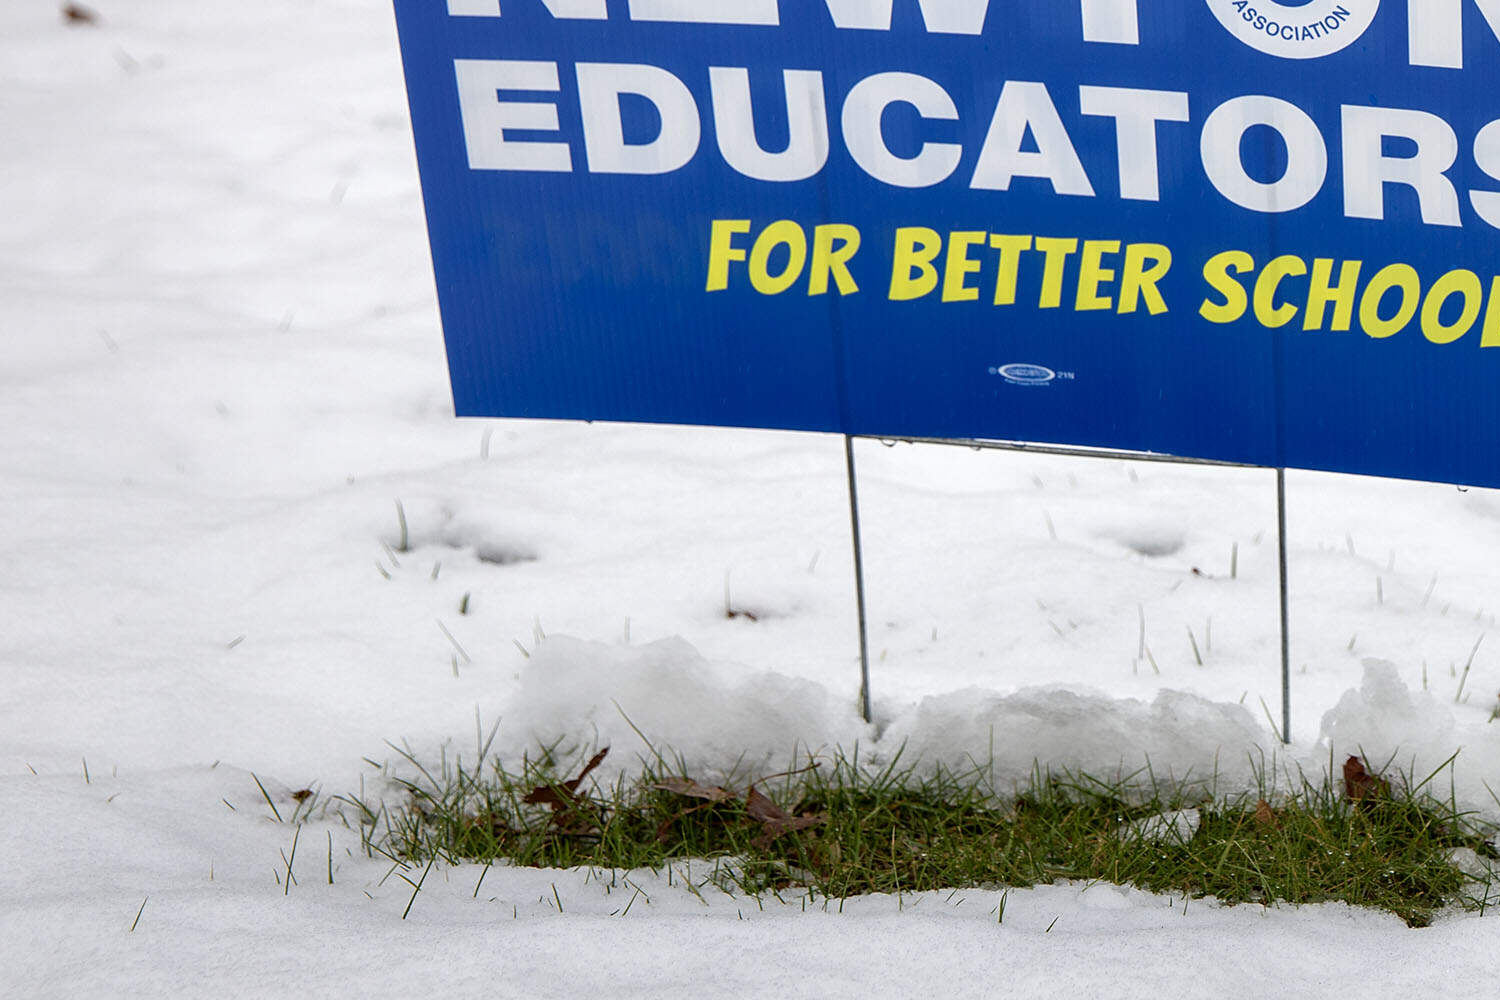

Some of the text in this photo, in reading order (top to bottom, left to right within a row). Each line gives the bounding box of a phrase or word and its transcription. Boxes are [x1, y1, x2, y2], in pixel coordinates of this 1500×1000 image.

[1232, 0, 1351, 41] ASSOCIATION
[707, 220, 860, 296] FOR
[889, 228, 1171, 314] BETTER
